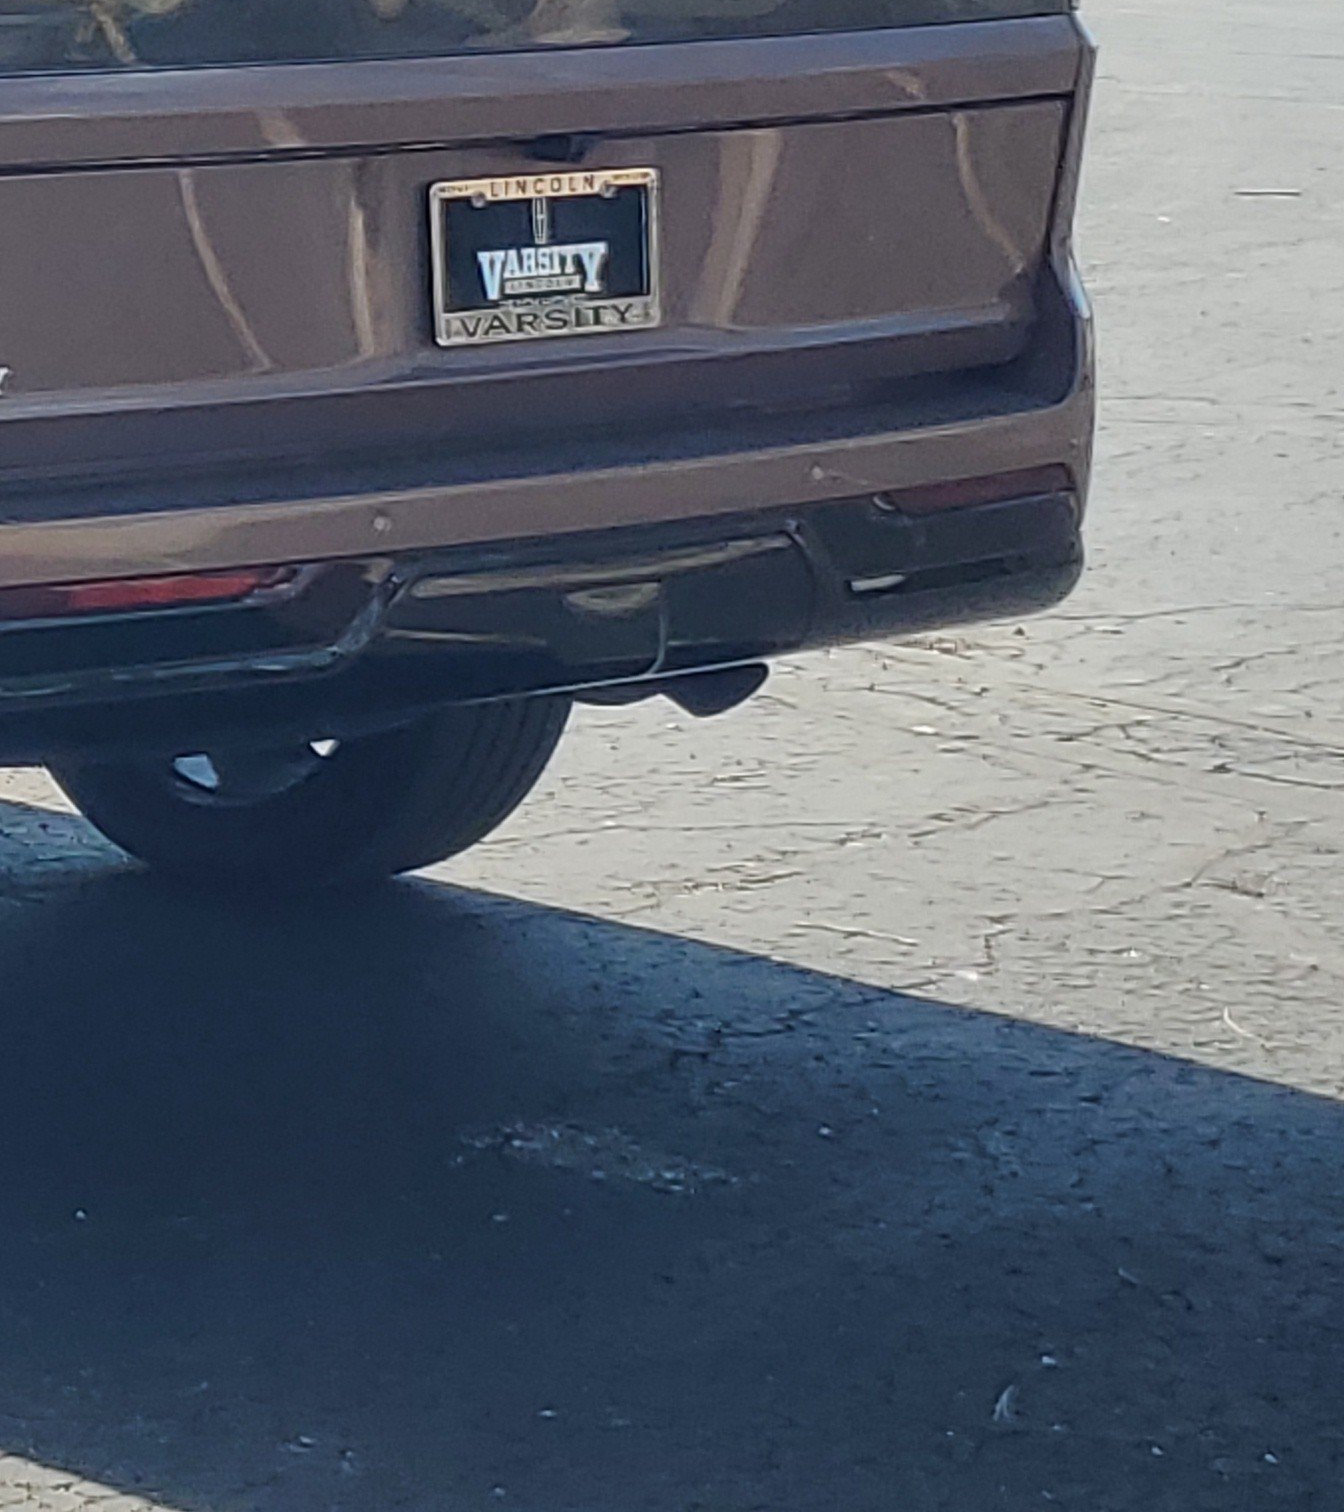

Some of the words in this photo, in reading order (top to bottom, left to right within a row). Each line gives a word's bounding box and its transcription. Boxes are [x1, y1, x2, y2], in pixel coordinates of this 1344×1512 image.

[490, 174, 595, 198] LINCOLN
[477, 241, 607, 300] VARSITY
[461, 304, 633, 338] VARSITY
